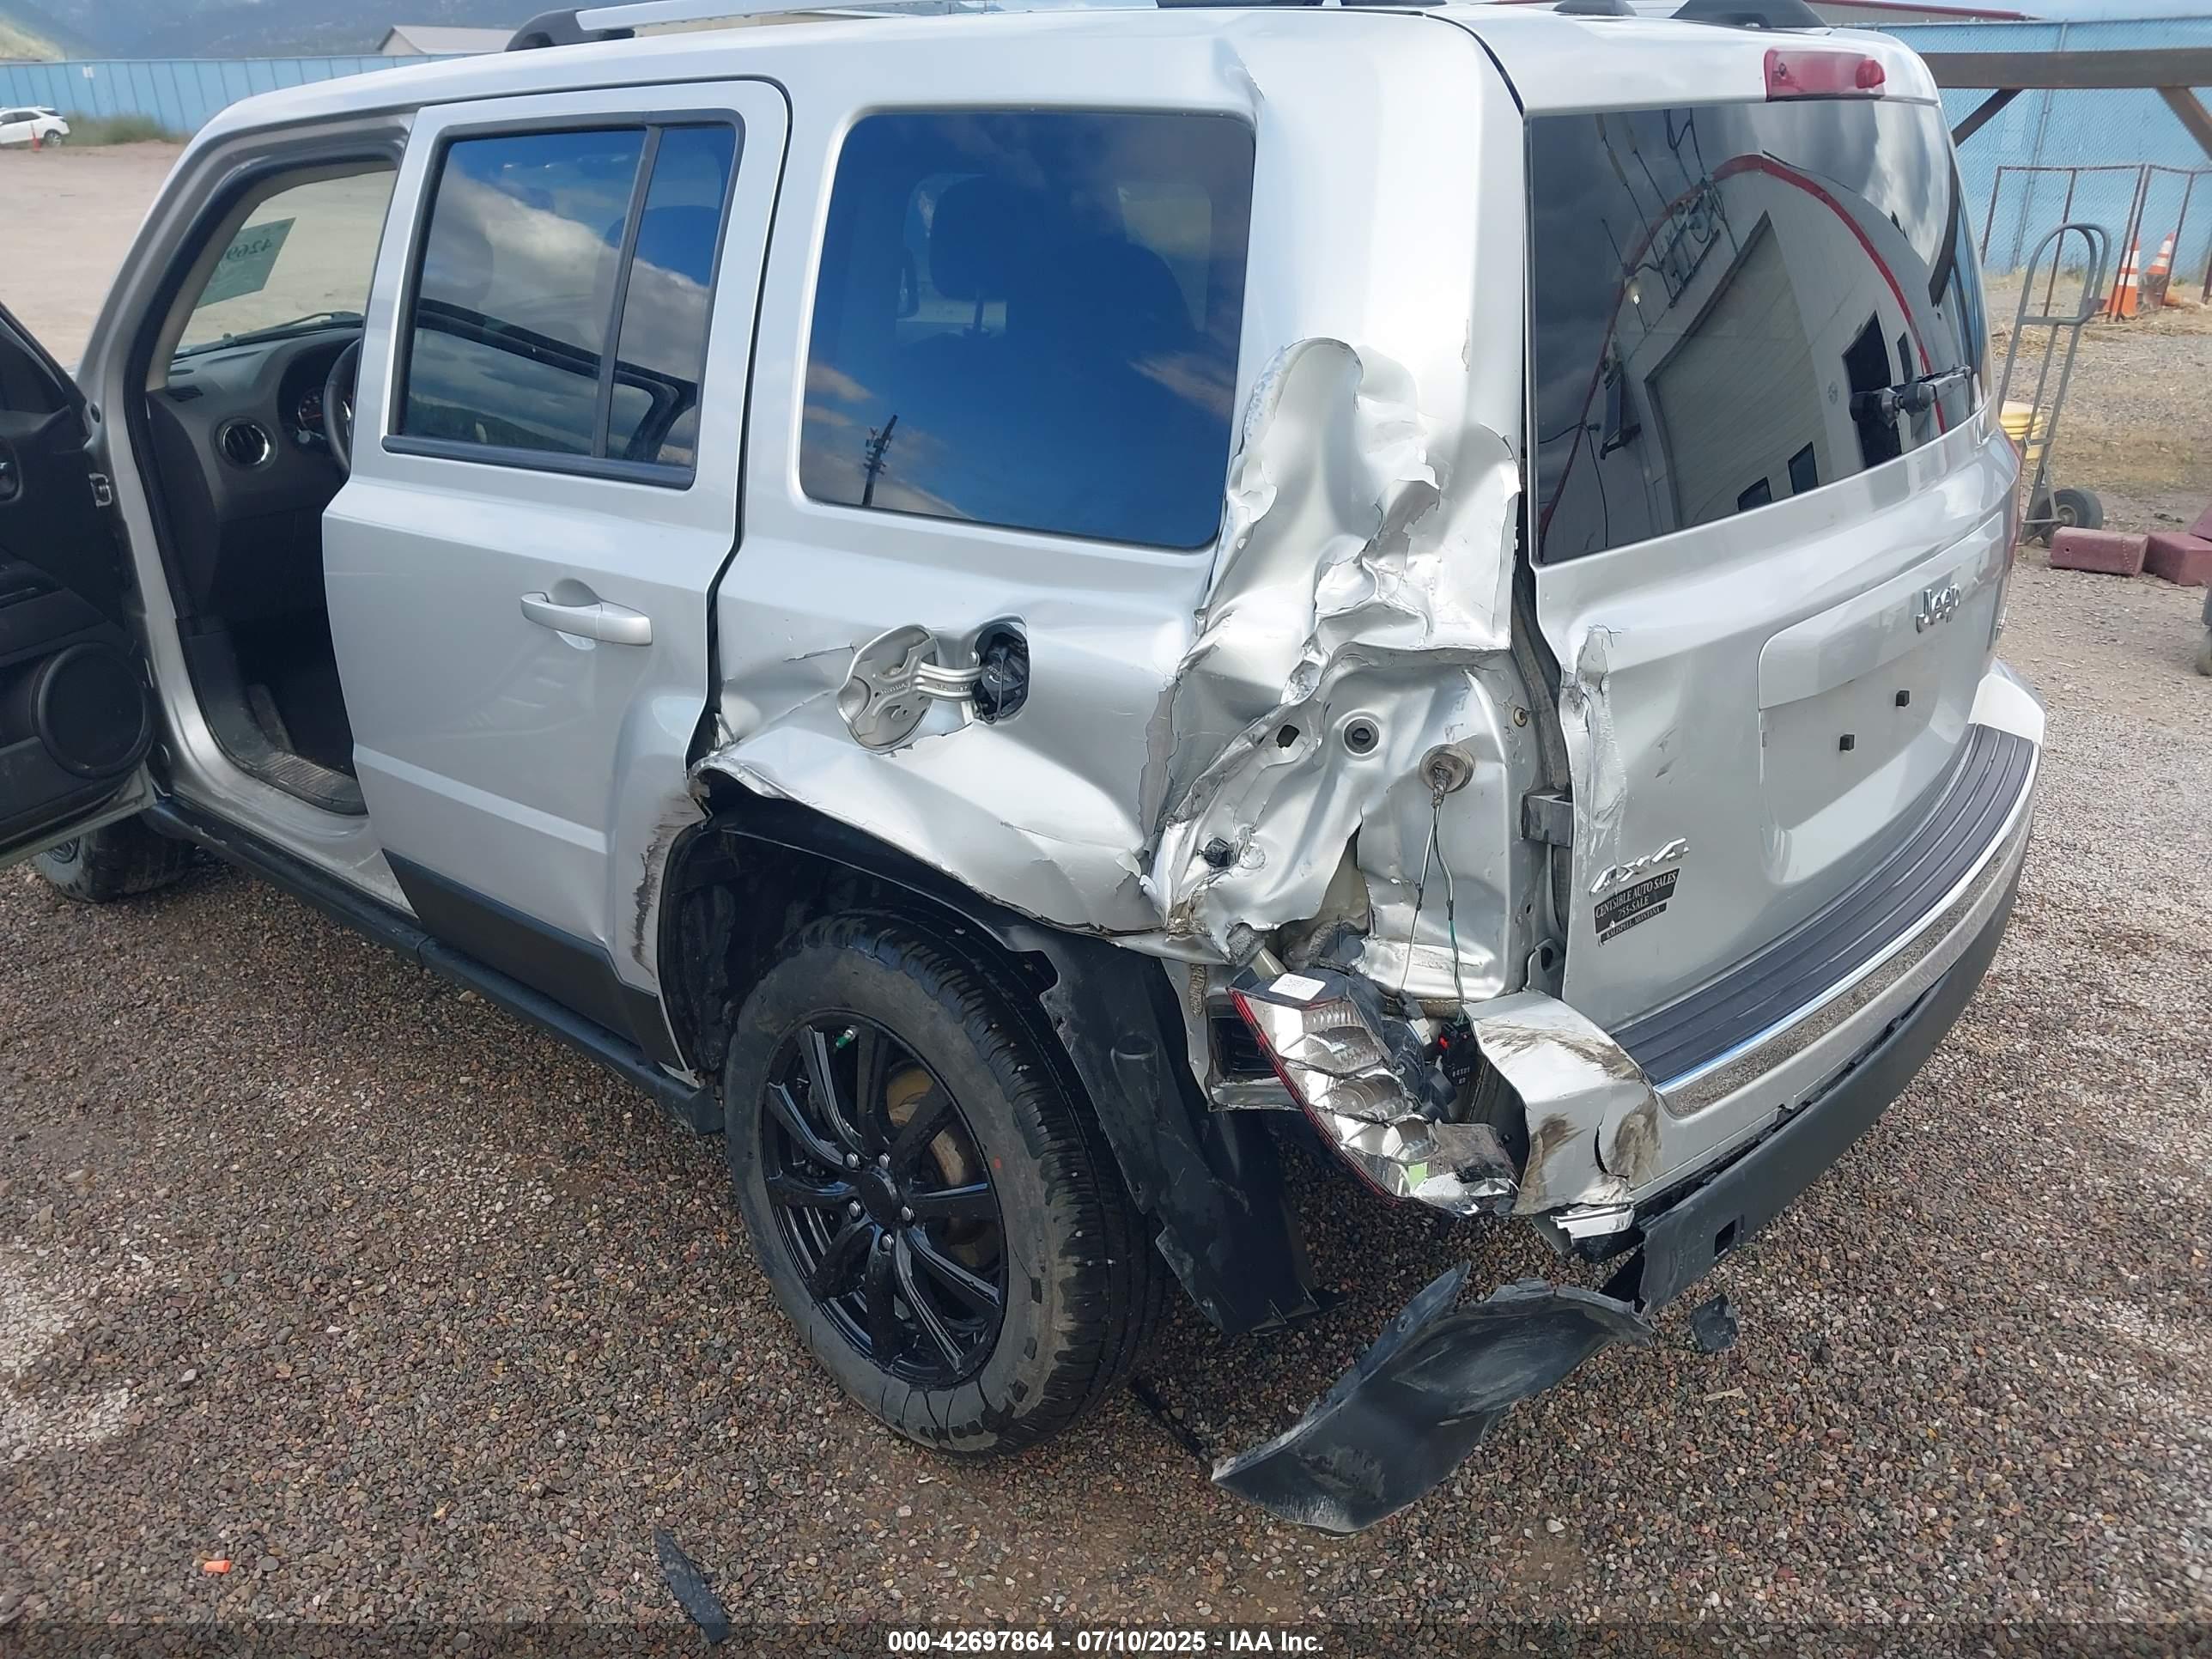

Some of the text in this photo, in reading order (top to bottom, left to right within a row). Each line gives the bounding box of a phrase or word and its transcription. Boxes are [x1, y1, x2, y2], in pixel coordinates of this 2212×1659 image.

[1914, 583, 1960, 623] Jeep
[1595, 871, 1678, 919] CENTSIBLE AUTO SALES
[1634, 906, 1661, 924] MONTANA
